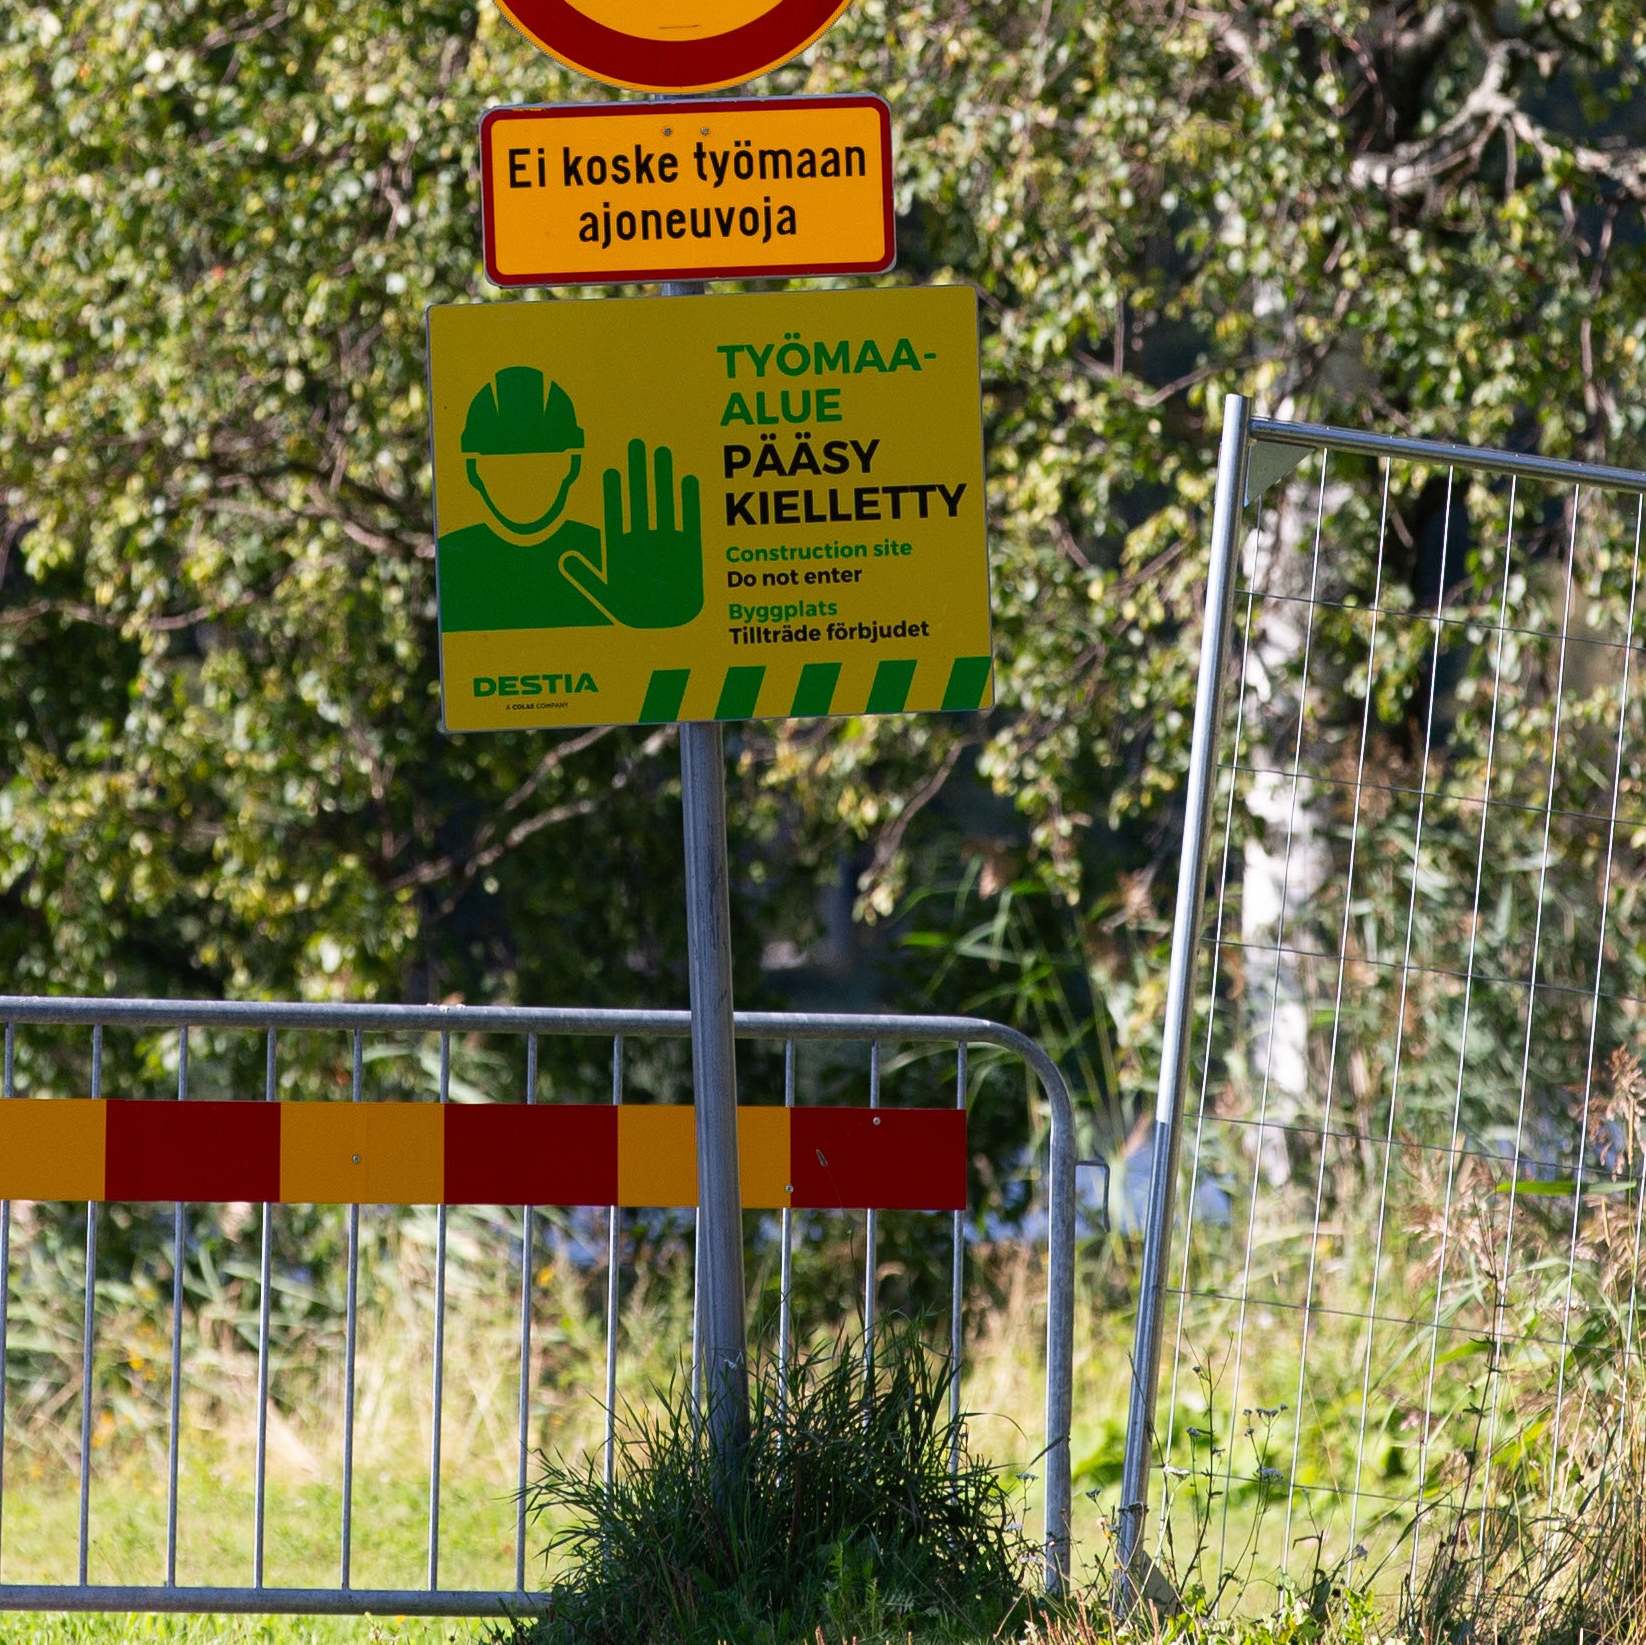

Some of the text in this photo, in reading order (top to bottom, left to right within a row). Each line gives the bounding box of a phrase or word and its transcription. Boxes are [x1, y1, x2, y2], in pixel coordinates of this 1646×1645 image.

[508, 140, 867, 189] Ei koske työmaan
[578, 196, 798, 249] ajoneuvoja
[717, 333, 937, 380] TYÖMAA-
[720, 388, 843, 427] ALUE
[723, 432, 880, 479] PÄÄSY
[724, 483, 967, 526] KIELLETTY
[725, 538, 913, 562] Construction site
[726, 565, 862, 588] Do not enter
[728, 600, 837, 624] Byggplats
[729, 620, 930, 644] Tillträde förbjudet
[473, 672, 599, 697] DESTIA
